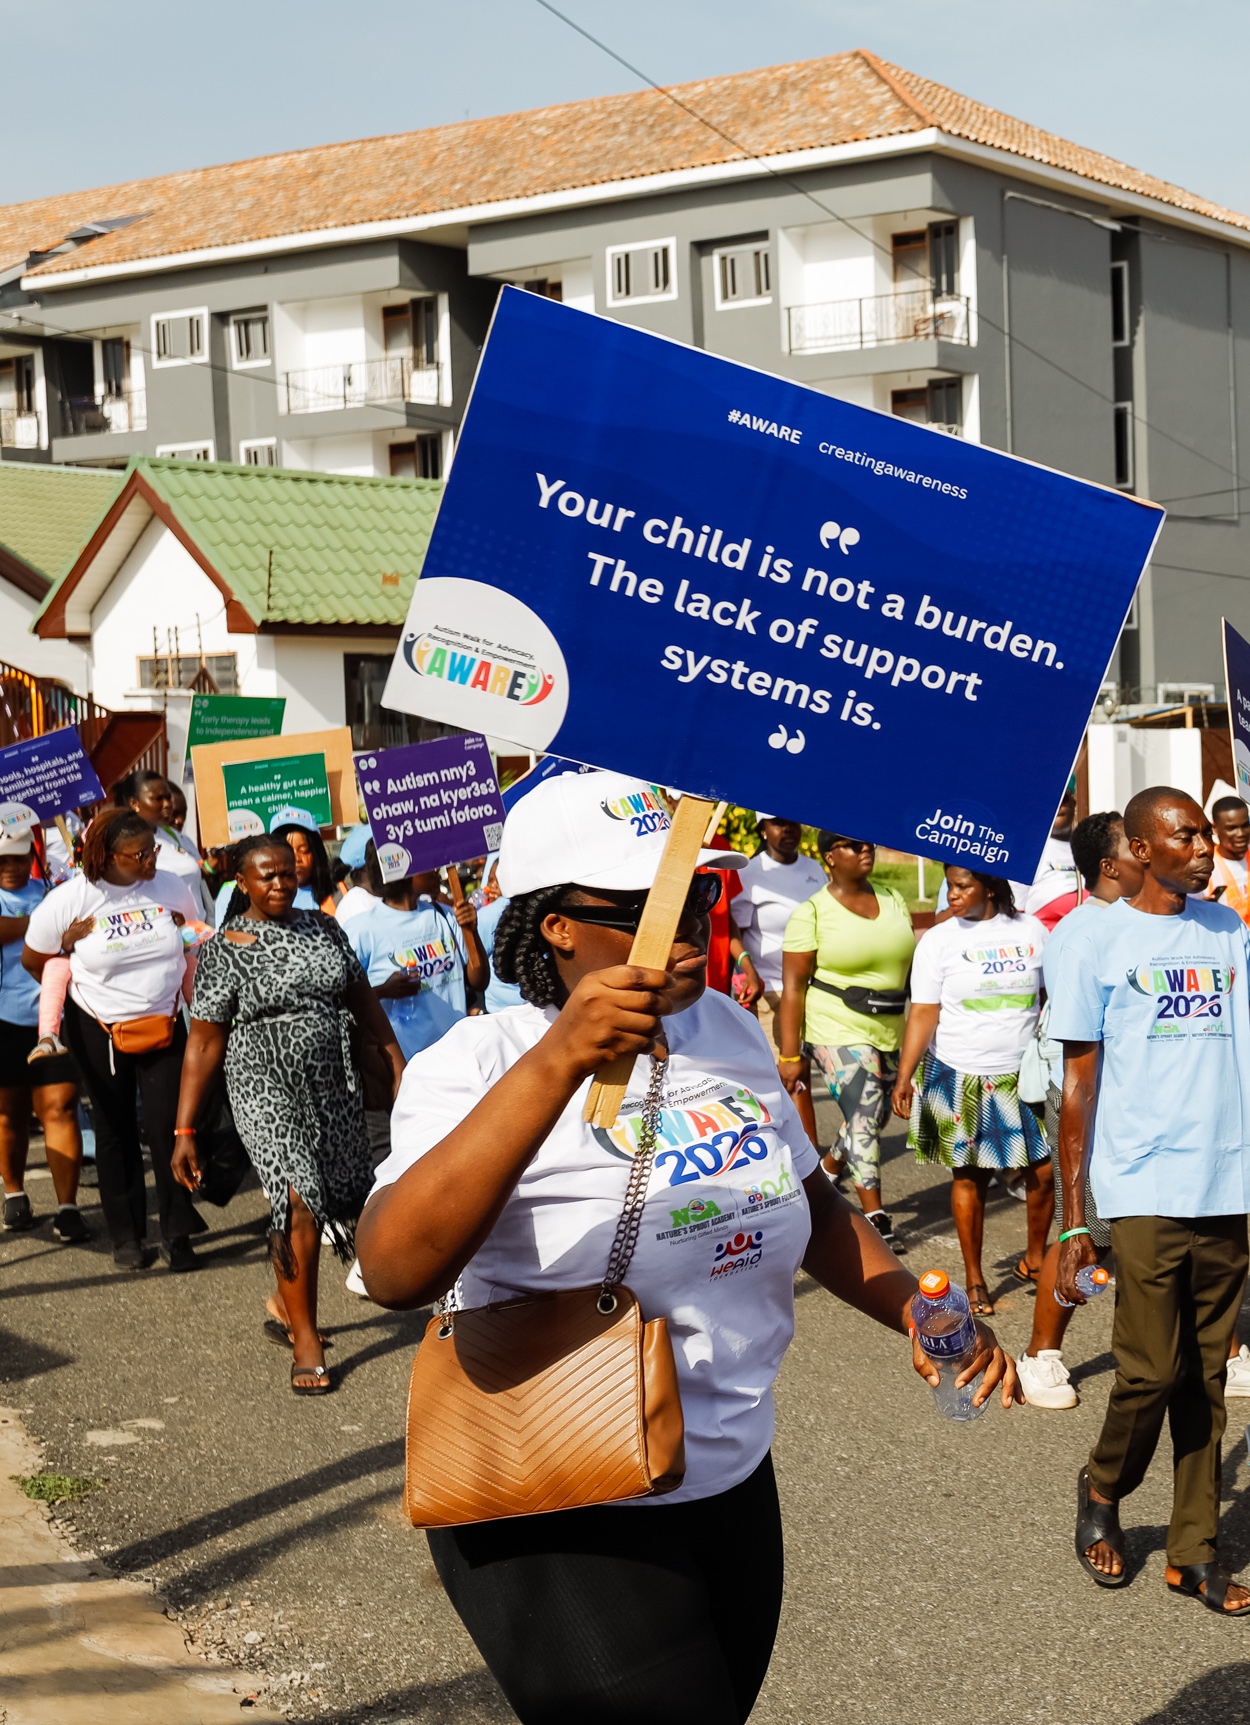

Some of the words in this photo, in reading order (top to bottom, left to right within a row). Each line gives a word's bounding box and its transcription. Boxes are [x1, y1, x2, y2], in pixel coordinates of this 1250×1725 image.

[728, 409, 803, 445] #AWARE
[818, 441, 968, 499] creatingawareness
[534, 472, 636, 532] Your
[642, 515, 753, 571] child
[757, 545, 794, 584] is
[801, 567, 876, 610] not
[881, 593, 906, 621] a
[914, 594, 1064, 670] burden.
[587, 551, 665, 604] The
[674, 578, 762, 635] lack
[768, 617, 820, 649] of
[819, 633, 983, 702] support
[427, 632, 473, 652] Recognition
[482, 649, 537, 670] Empowerment
[433, 625, 461, 637] Autism
[463, 630, 480, 643] Walk
[482, 637, 494, 647] for
[497, 643, 535, 660] Advocacy,
[426, 647, 527, 701] AWARE
[660, 645, 833, 714] systems
[840, 689, 882, 731] is.
[1236, 688, 1242, 704] A
[196, 727, 204, 735] to
[205, 727, 258, 737] independence
[200, 715, 219, 726] Early
[221, 716, 250, 726] therapy
[24, 756, 68, 776] hospitals,
[67, 748, 84, 761] and
[387, 771, 439, 794] Autism
[440, 760, 476, 783] nny3
[0, 777, 36, 795] families
[36, 769, 58, 783] must
[58, 762, 80, 776] work
[7, 783, 44, 802] together
[45, 777, 67, 790] from
[67, 772, 82, 783] the
[240, 786, 247, 794] A
[248, 782, 281, 793] healthy
[283, 779, 296, 790] gut
[299, 777, 314, 786] can
[38, 790, 62, 804] start.
[229, 798, 253, 808] mean
[262, 792, 293, 804] calmer,
[294, 787, 327, 799] happier
[372, 799, 419, 820] ohaw,
[420, 794, 440, 809] na
[440, 778, 496, 807] kyer3s3
[618, 791, 666, 817] AWAR
[386, 820, 413, 843] 3y3
[415, 810, 451, 833] tumi
[451, 804, 497, 828] foforo.
[925, 808, 975, 837] Join
[978, 825, 1005, 844] The
[914, 823, 1010, 863] Campaign
[977, 946, 1025, 961] AWARE
[981, 959, 1026, 975] 2026
[1152, 968, 1223, 993] AWARE
[1157, 994, 1222, 1019] 2026
[655, 1123, 768, 1187] 2026
[656, 1227, 688, 1241] NATURE'S
[689, 1220, 711, 1233] SPROUT
[711, 1212, 735, 1226] ACADEMY
[669, 1235, 697, 1246] Nurturing
